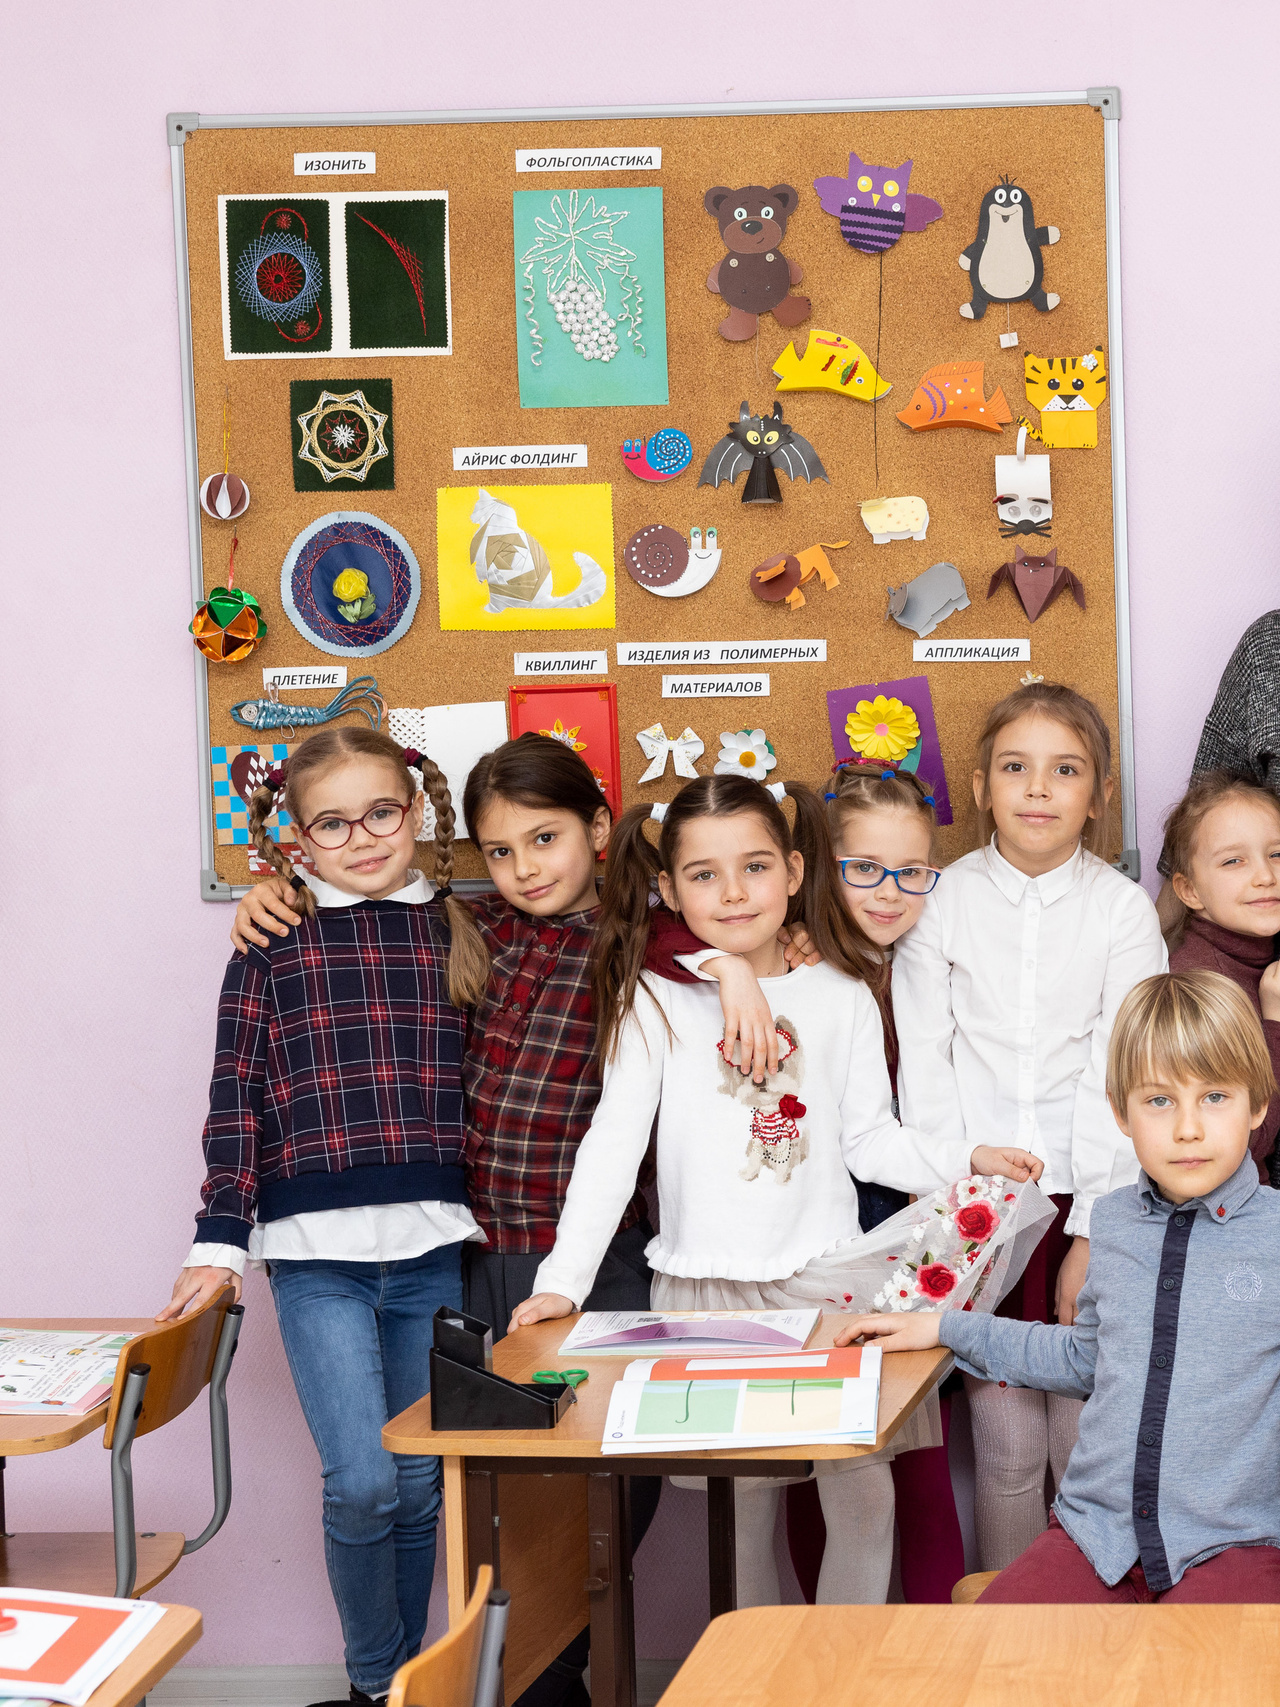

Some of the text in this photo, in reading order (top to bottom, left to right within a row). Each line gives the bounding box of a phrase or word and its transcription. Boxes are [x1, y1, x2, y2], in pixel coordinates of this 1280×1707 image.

[304, 159, 367, 171] ИЗОНИТЬ
[526, 155, 653, 168] ФОЛЬГОПЛАСТИКА
[461, 453, 578, 467] АЙРИС ФОЛДИНГ
[627, 647, 819, 664] ИЗДЕЛИЯ ИЗ ПОЛИМЕРНЫХ
[924, 646, 1020, 660] АППЛИКАЦИЯ
[525, 659, 598, 672] КВИЛЛИНГ
[272, 673, 339, 686] ПЛЕТЕНИЕ
[670, 681, 763, 694] МАТЕРИАЛОВ
